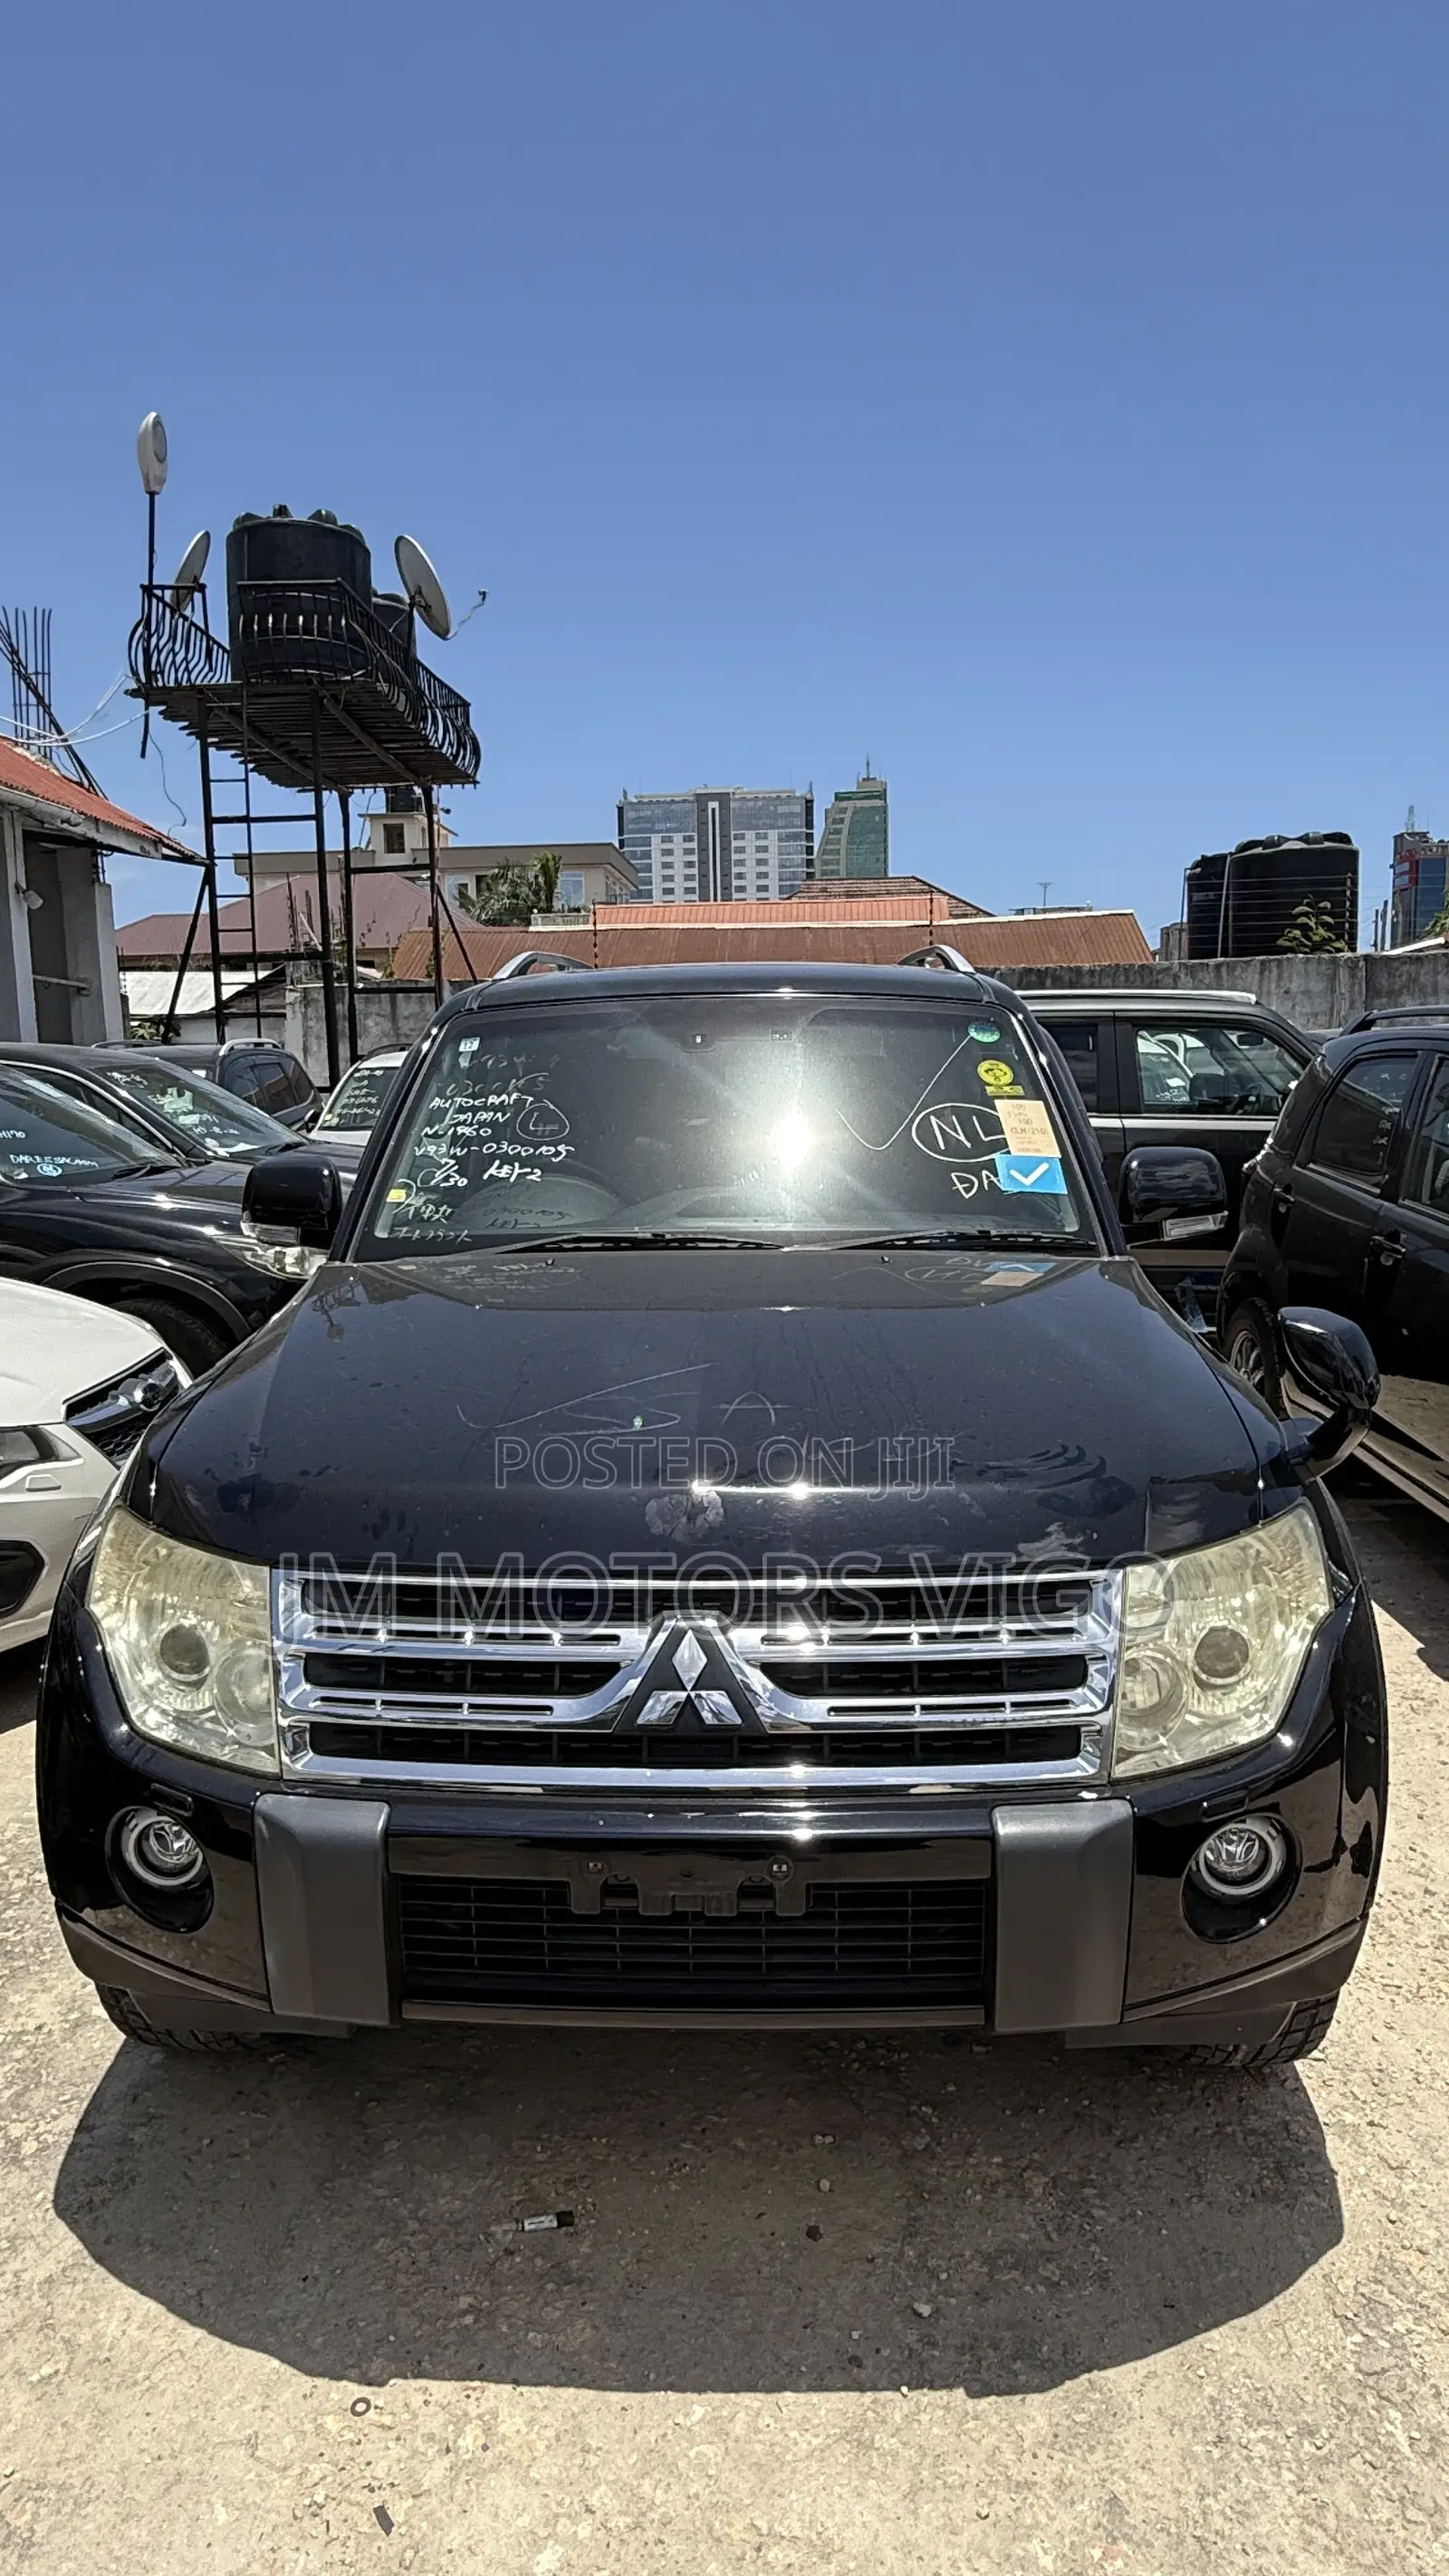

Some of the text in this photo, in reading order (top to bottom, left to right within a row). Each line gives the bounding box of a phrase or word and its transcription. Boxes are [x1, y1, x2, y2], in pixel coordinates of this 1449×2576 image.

[428, 1092, 534, 1109] AUTOCRAFT
[449, 1112, 511, 1125] JAPAN
[951, 1169, 1005, 1200] DA
